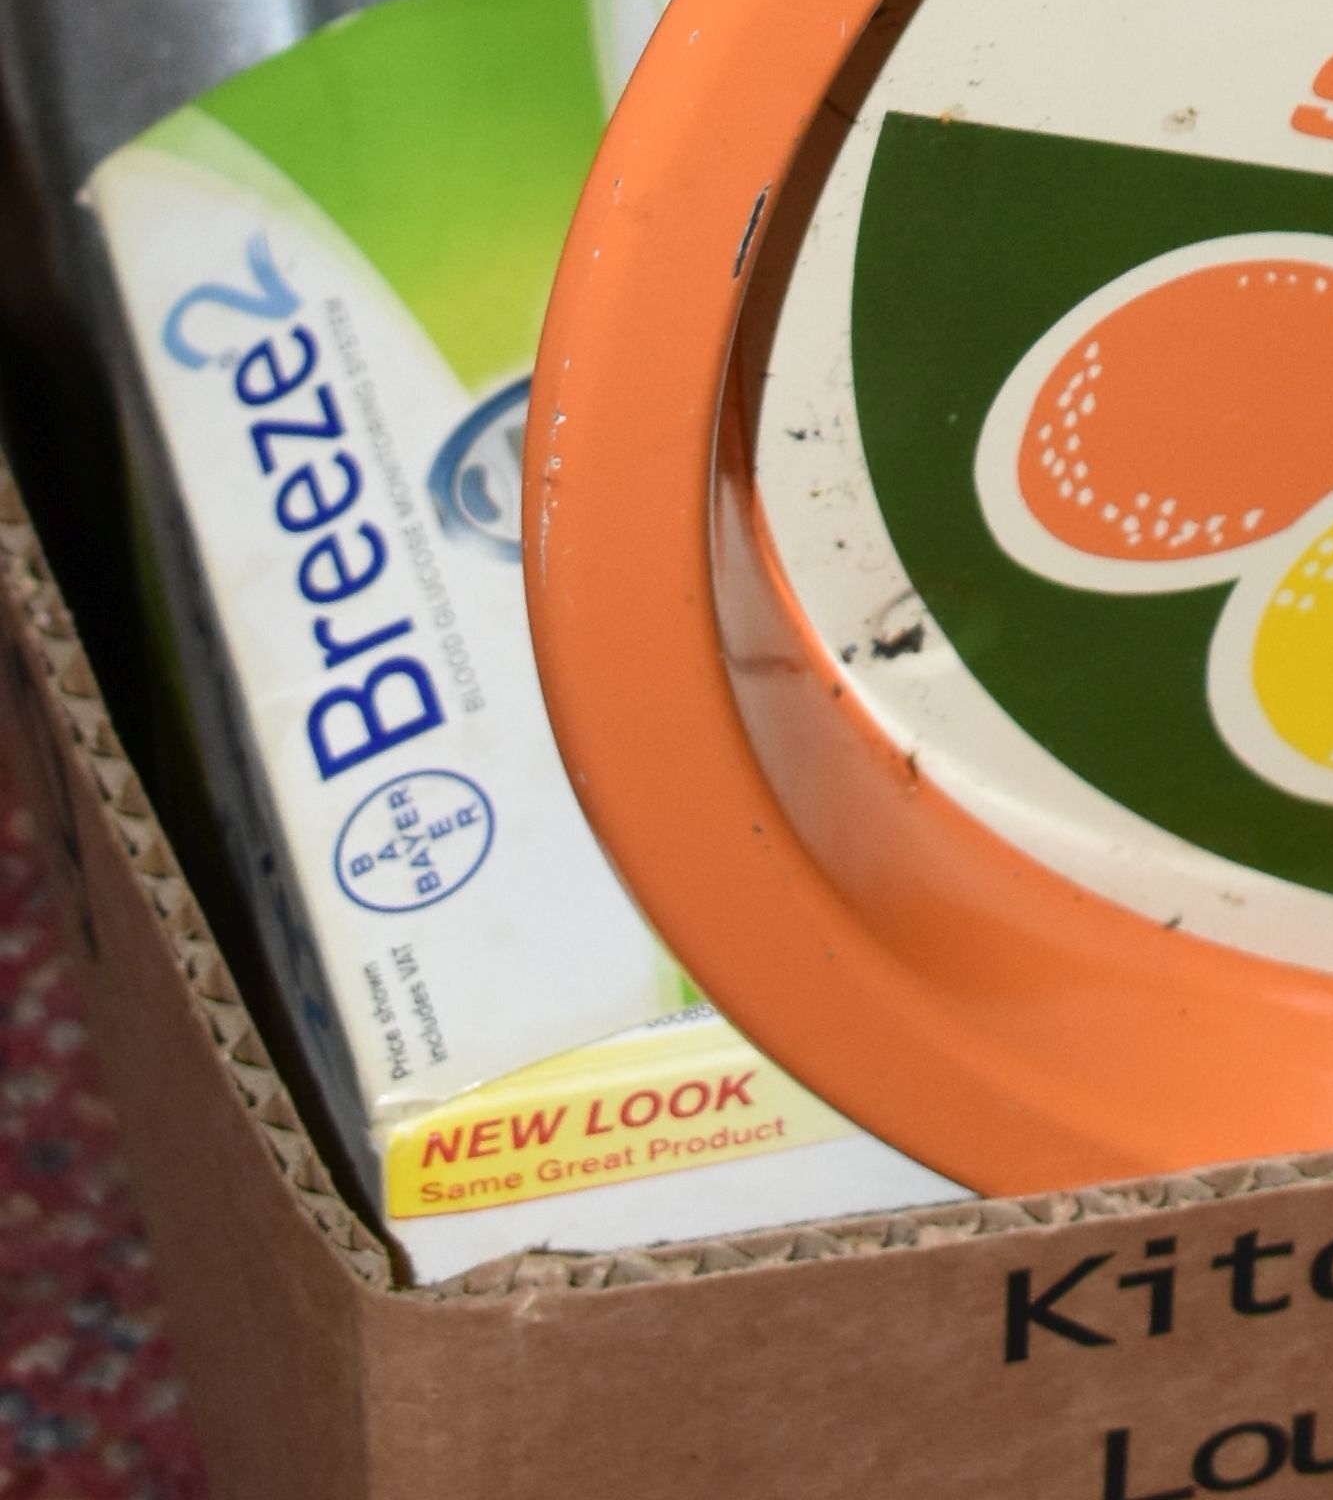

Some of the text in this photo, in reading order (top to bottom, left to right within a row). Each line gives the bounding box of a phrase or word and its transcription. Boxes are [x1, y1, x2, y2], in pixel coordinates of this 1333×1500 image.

[325, 297, 486, 715] BLOOD GLUCOSE MONITORING SYSTEM
[391, 942, 420, 982] VAT
[364, 960, 412, 1082] Price shown
[419, 1115, 788, 1205] Same Great Product
[420, 1070, 759, 1168] NEW LOOK
